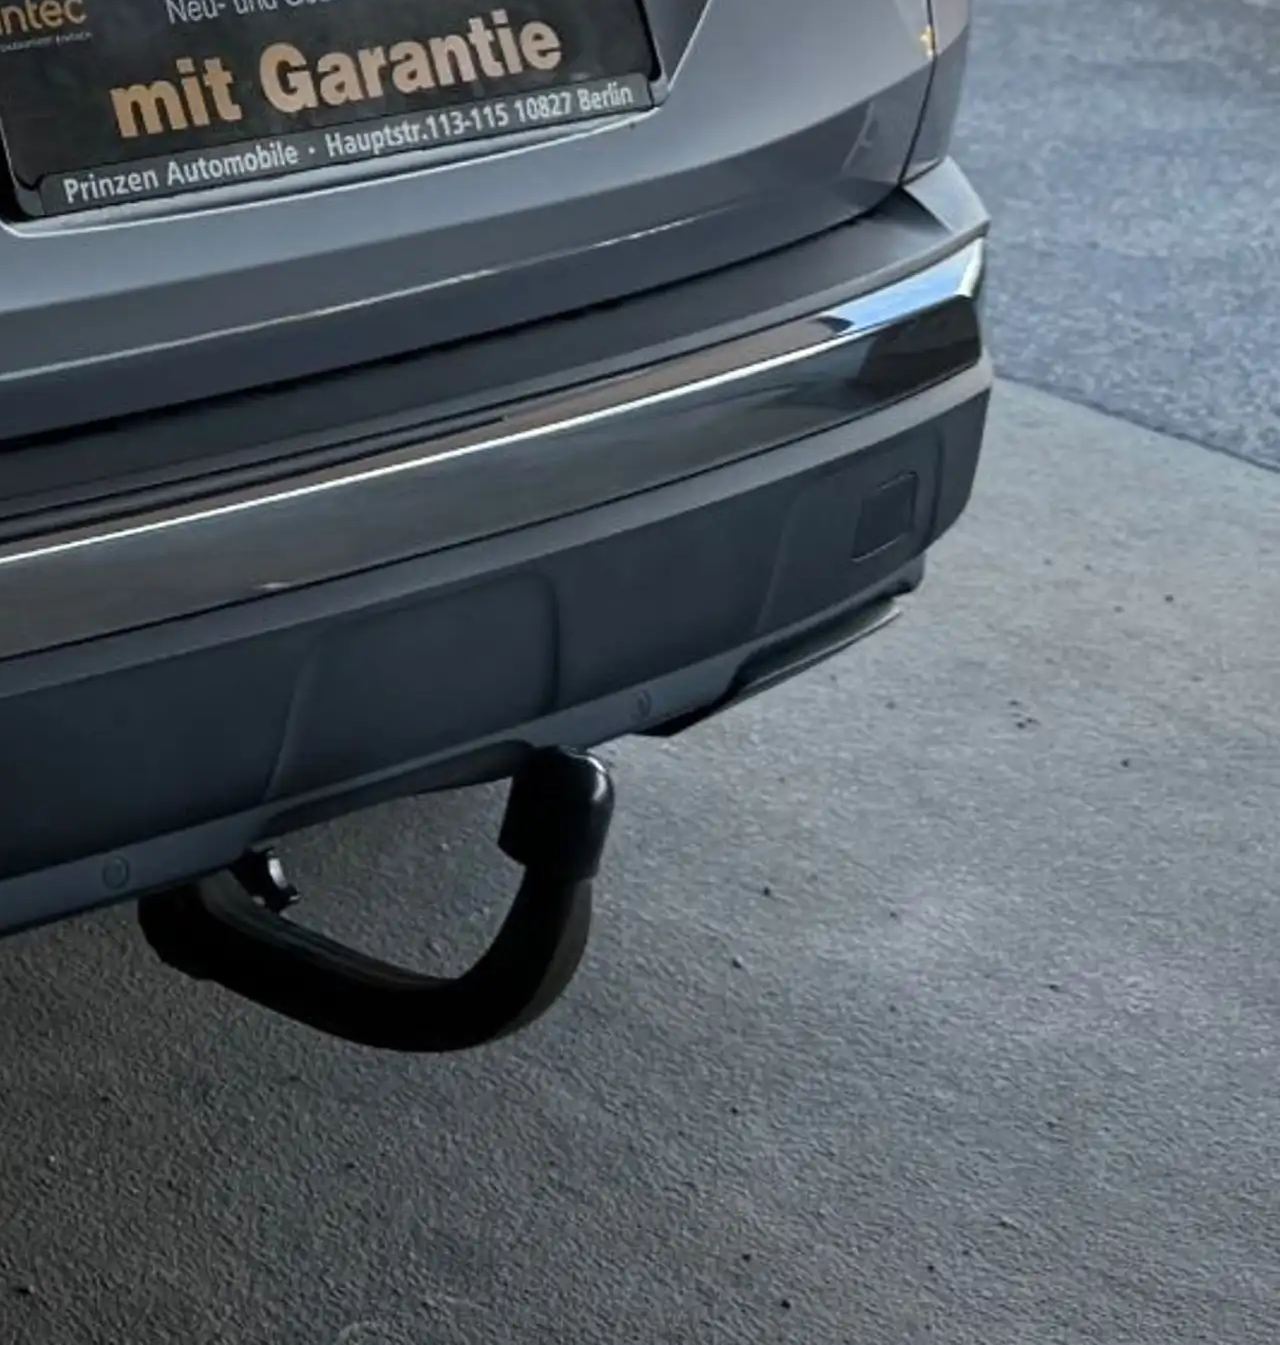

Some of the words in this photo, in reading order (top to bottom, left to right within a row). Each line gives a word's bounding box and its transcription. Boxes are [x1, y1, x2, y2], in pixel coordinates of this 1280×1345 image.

[109, 57, 242, 138] mit
[259, 9, 561, 113] Garantie
[63, 168, 160, 204] Prinzen
[166, 143, 300, 187] Automobile
[513, 94, 572, 123] 10827
[576, 81, 634, 111] Berlin
